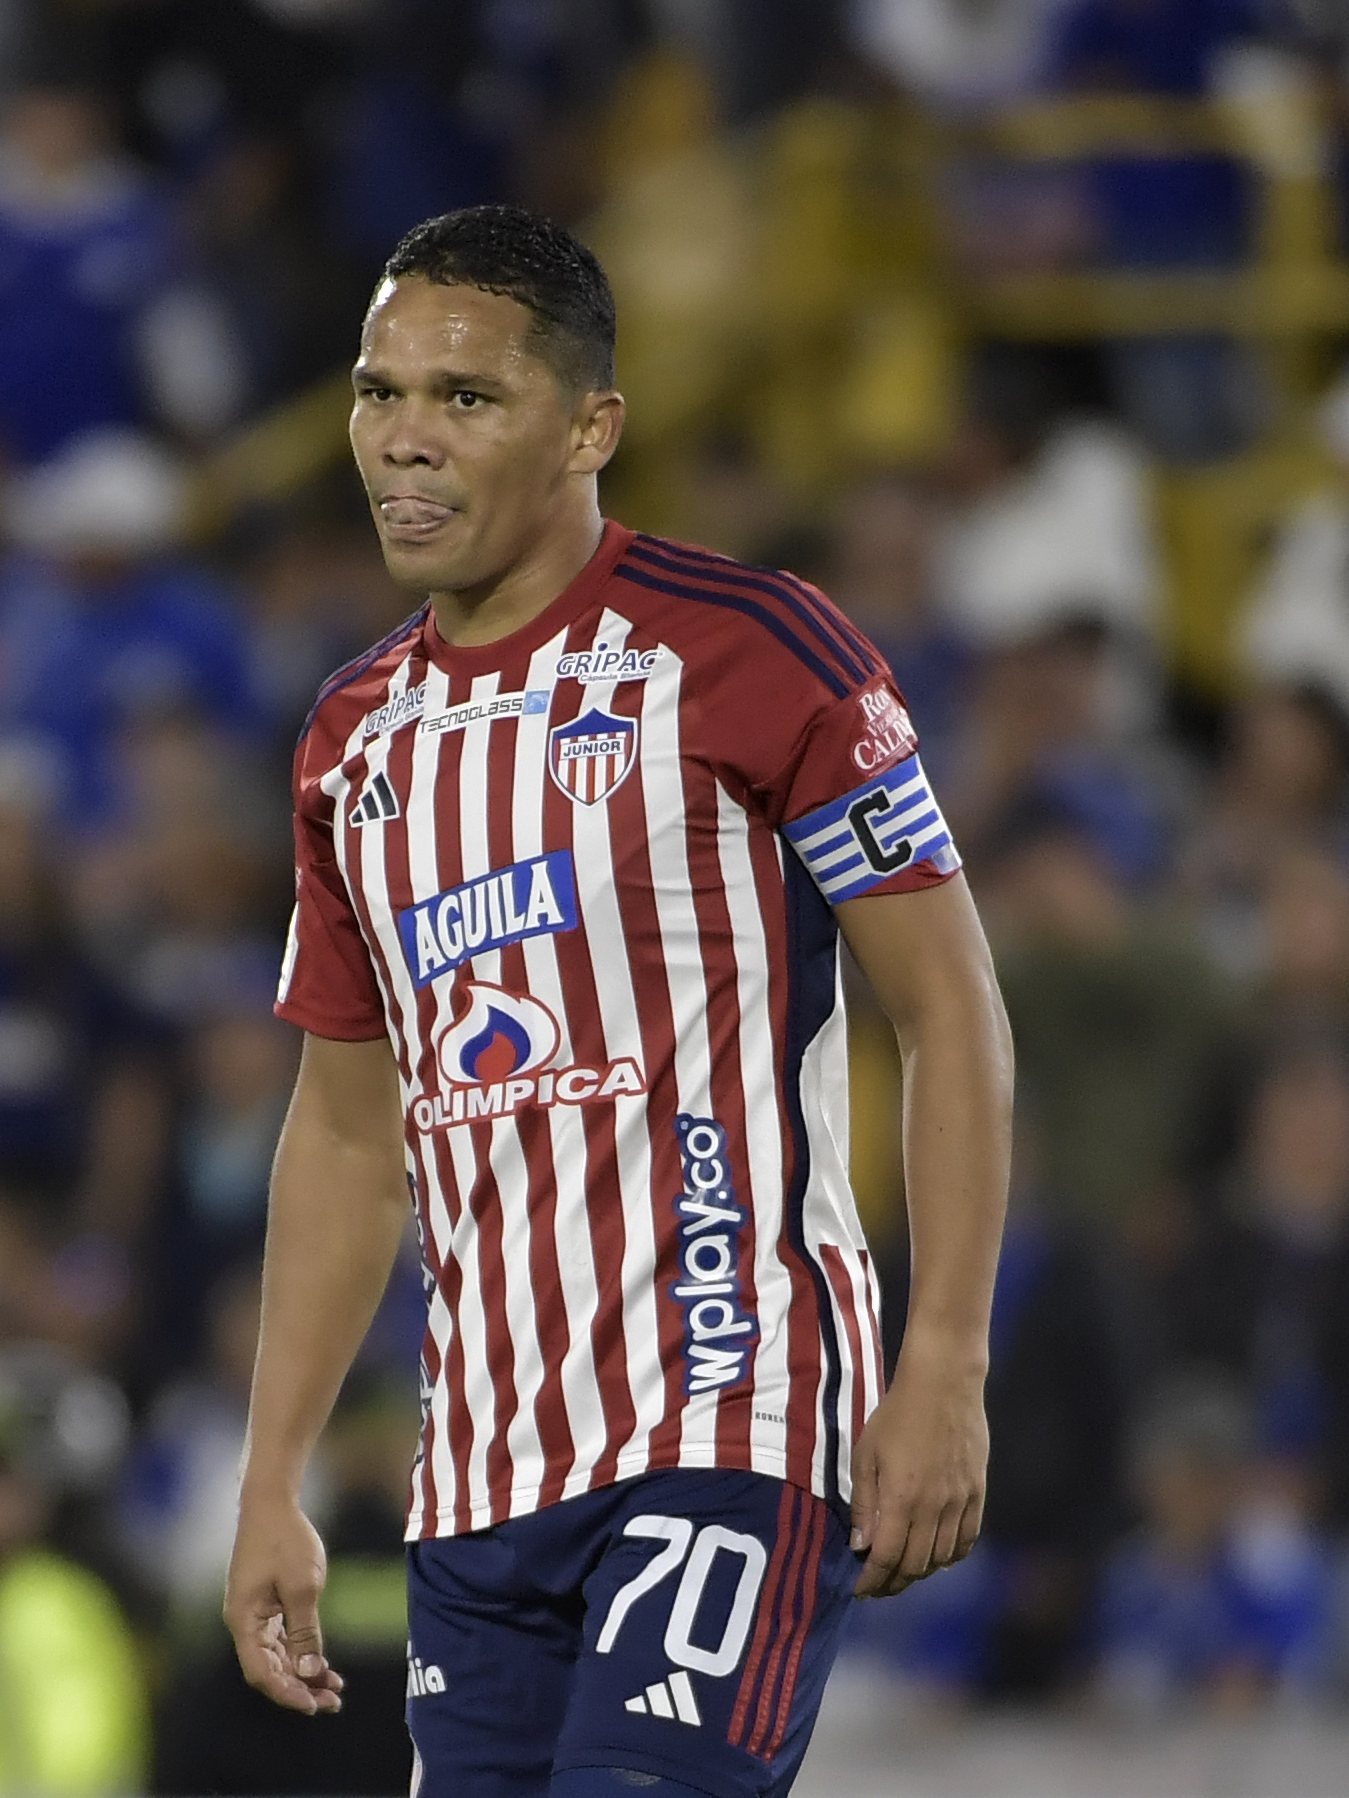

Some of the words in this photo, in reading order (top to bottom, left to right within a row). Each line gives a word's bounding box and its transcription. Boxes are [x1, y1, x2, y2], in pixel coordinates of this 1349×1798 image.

[563, 740, 621, 757] JUNIOR
[848, 789, 913, 873] C
[414, 860, 565, 980] AGUILA
[413, 1062, 643, 1131] OLIMPICA
[674, 1125, 752, 1391] wplay.co
[595, 1514, 767, 1677] 70
